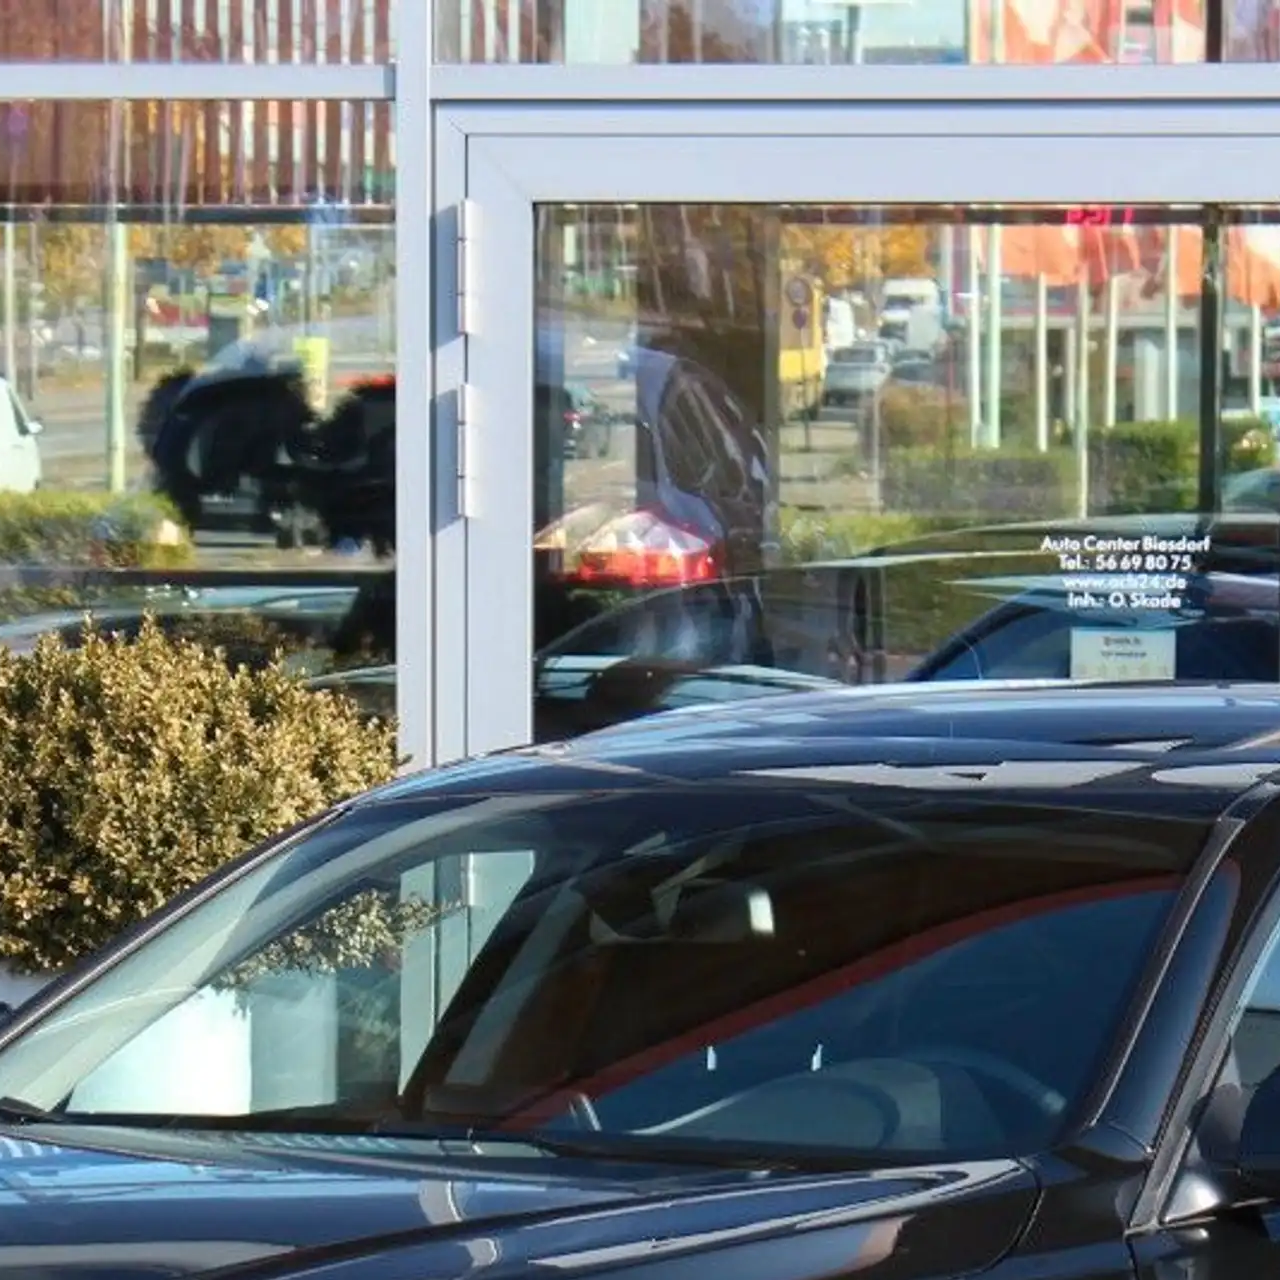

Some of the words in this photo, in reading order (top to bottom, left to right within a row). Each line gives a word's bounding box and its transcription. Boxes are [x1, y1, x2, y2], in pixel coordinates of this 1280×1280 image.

[1040, 534, 1081, 551] Auto
[1083, 534, 1139, 551] Center
[1142, 534, 1211, 551] Biesdorf
[1058, 554, 1090, 570] Tel.:
[1095, 554, 1117, 570] 56
[1121, 554, 1142, 570] 69
[1145, 554, 1168, 570] 80
[1170, 554, 1192, 570] 75
[1063, 574, 1188, 589] www.acb24.de
[1067, 592, 1104, 608] Inh.:
[1128, 592, 1182, 608] Skade
